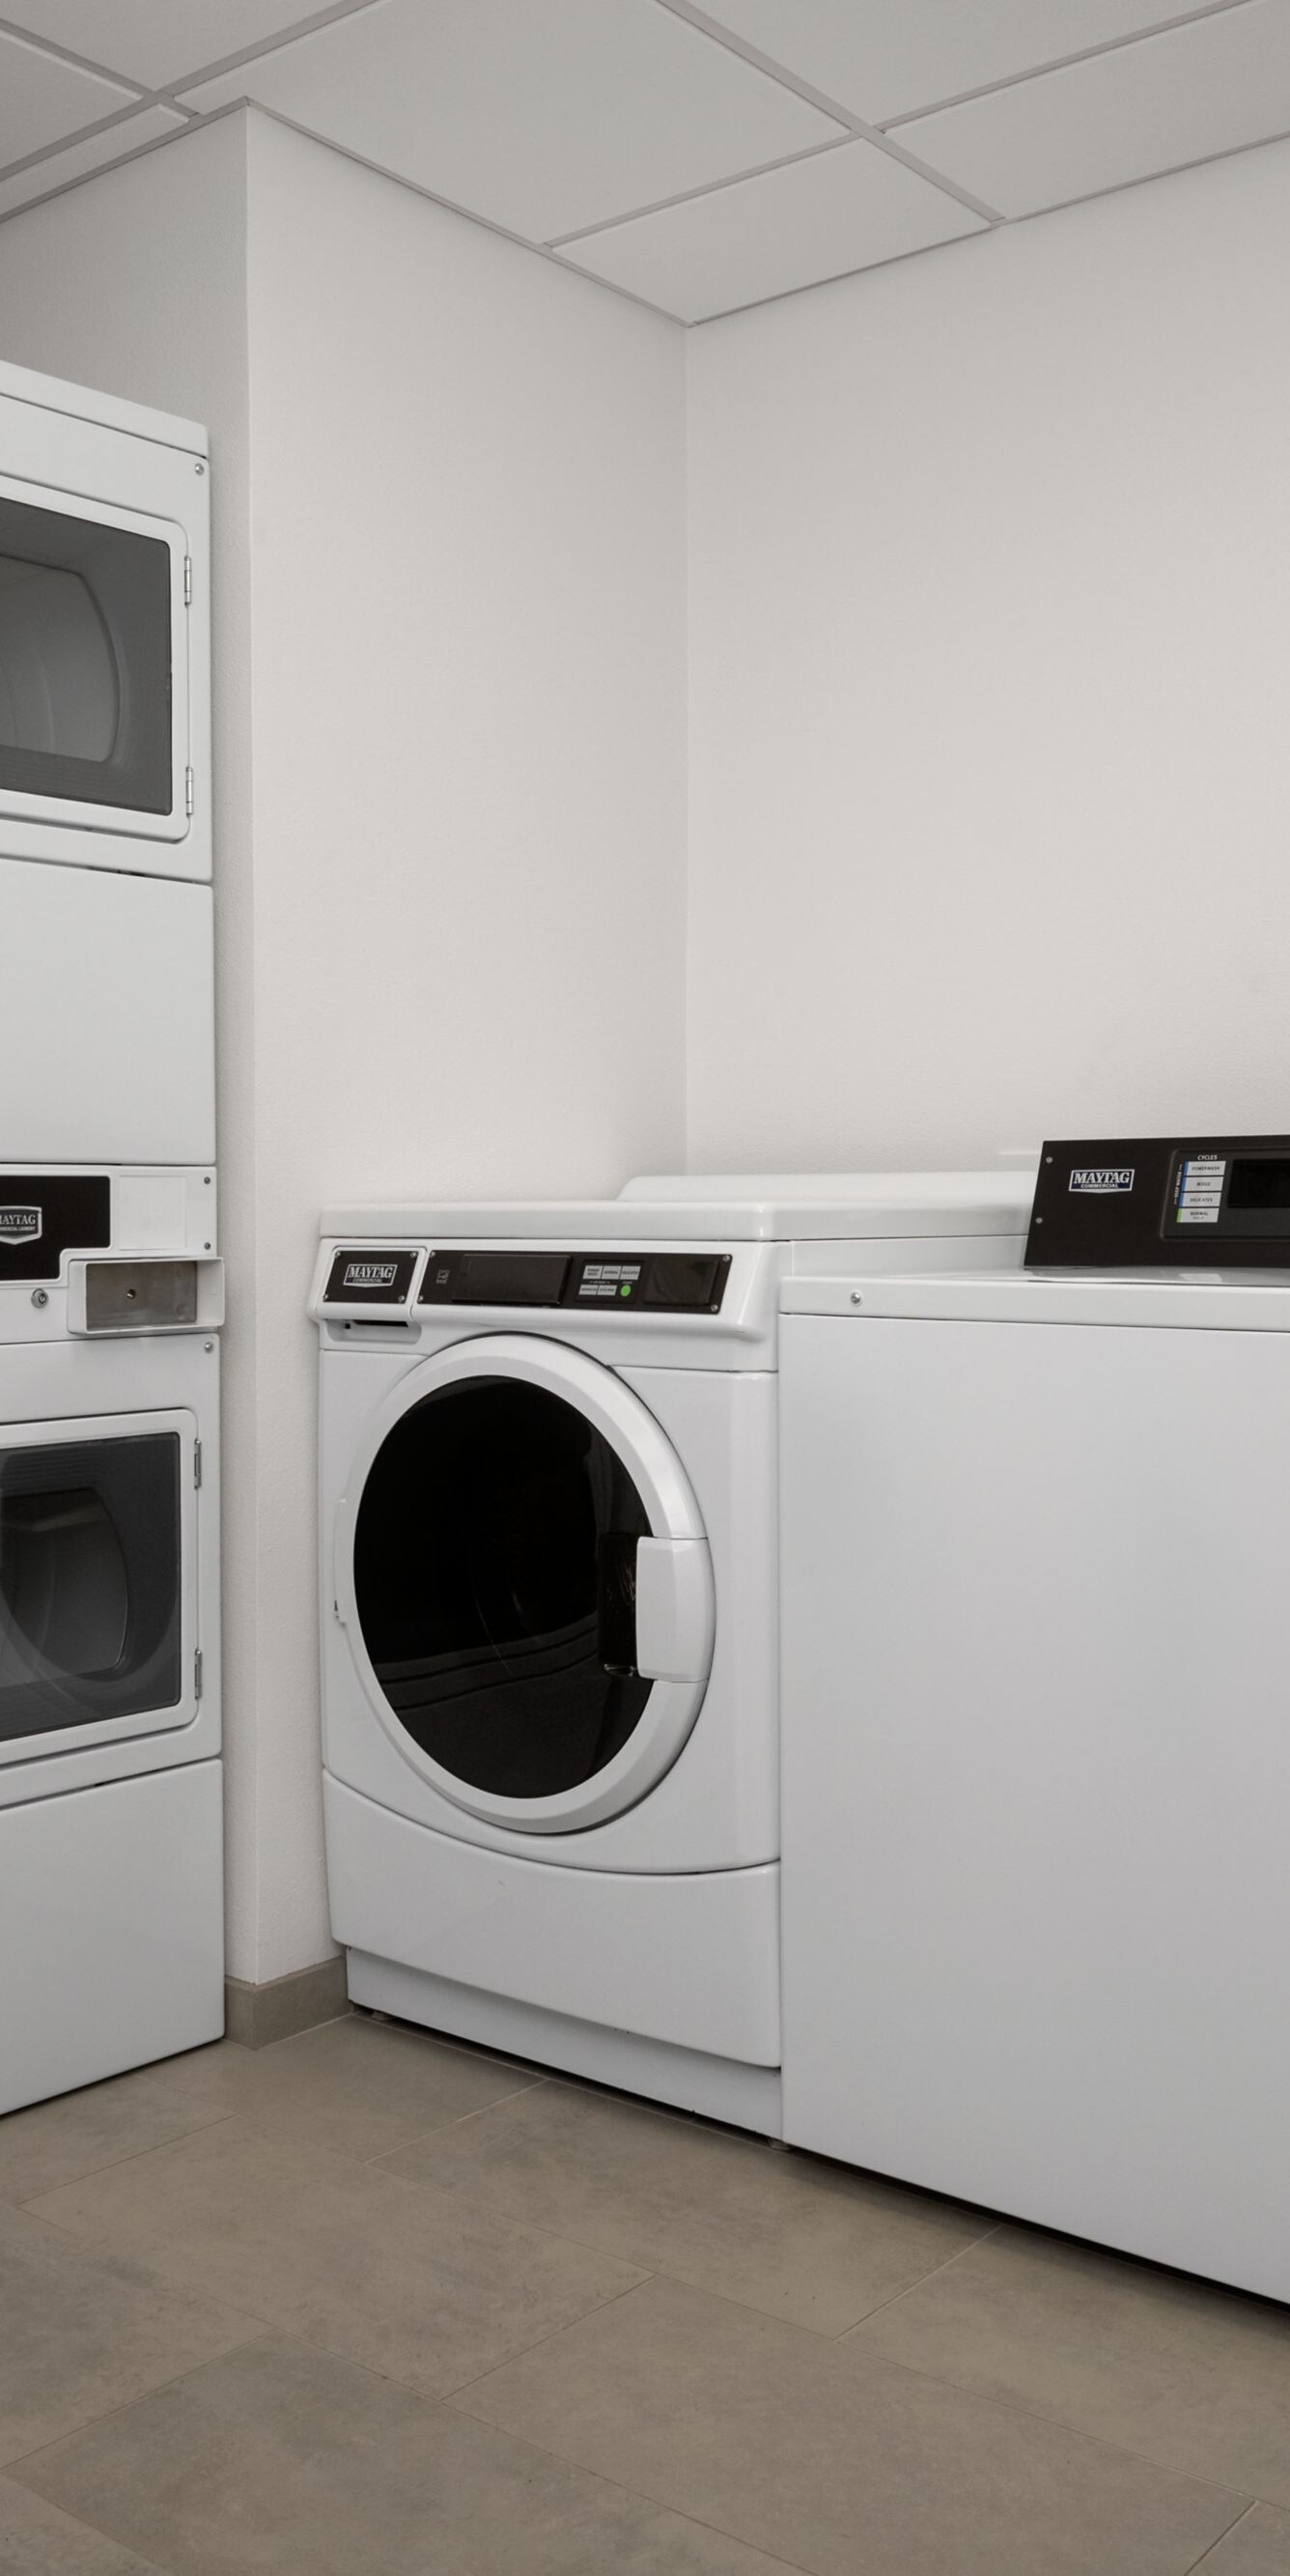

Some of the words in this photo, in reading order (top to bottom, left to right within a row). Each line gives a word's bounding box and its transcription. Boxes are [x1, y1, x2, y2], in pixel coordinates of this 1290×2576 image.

[1073, 1172, 1130, 1183] MAYTAG
[0, 1214, 36, 1225] AYTAG
[348, 1266, 393, 1278] MAYTAG
